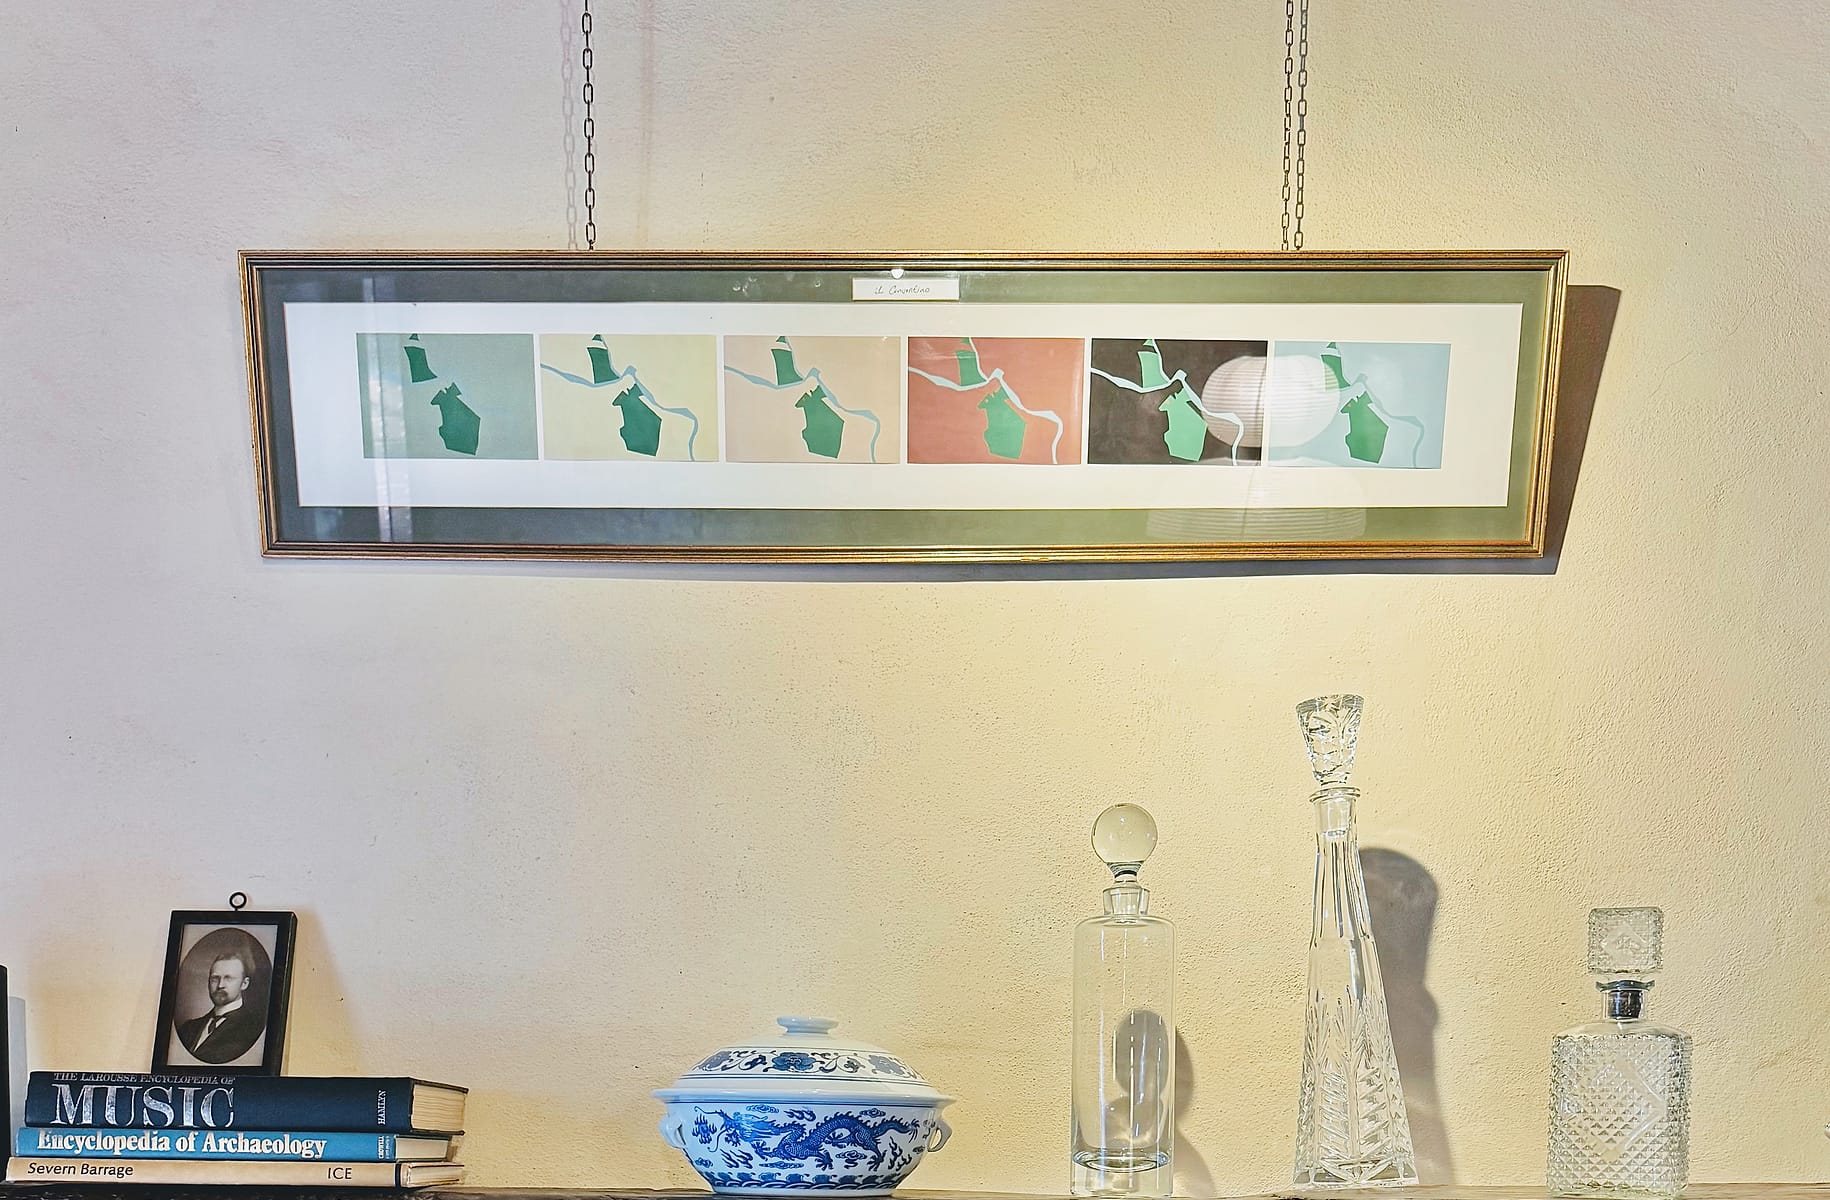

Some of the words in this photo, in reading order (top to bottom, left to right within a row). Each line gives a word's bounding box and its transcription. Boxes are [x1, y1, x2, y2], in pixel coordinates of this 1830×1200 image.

[54, 1072, 78, 1082] THE
[80, 1073, 137, 1083] LAROUSSE
[140, 1074, 218, 1084] ENCYCLOPEDIA
[50, 1083, 235, 1128] MUSIC
[377, 1090, 386, 1125] HAMLYN
[37, 1131, 171, 1156] Encyclopedia
[176, 1131, 200, 1152] of
[202, 1132, 326, 1159] Archaeology
[27, 1162, 77, 1176] Severn
[80, 1163, 133, 1179] Barrage
[327, 1167, 352, 1180] ICE
